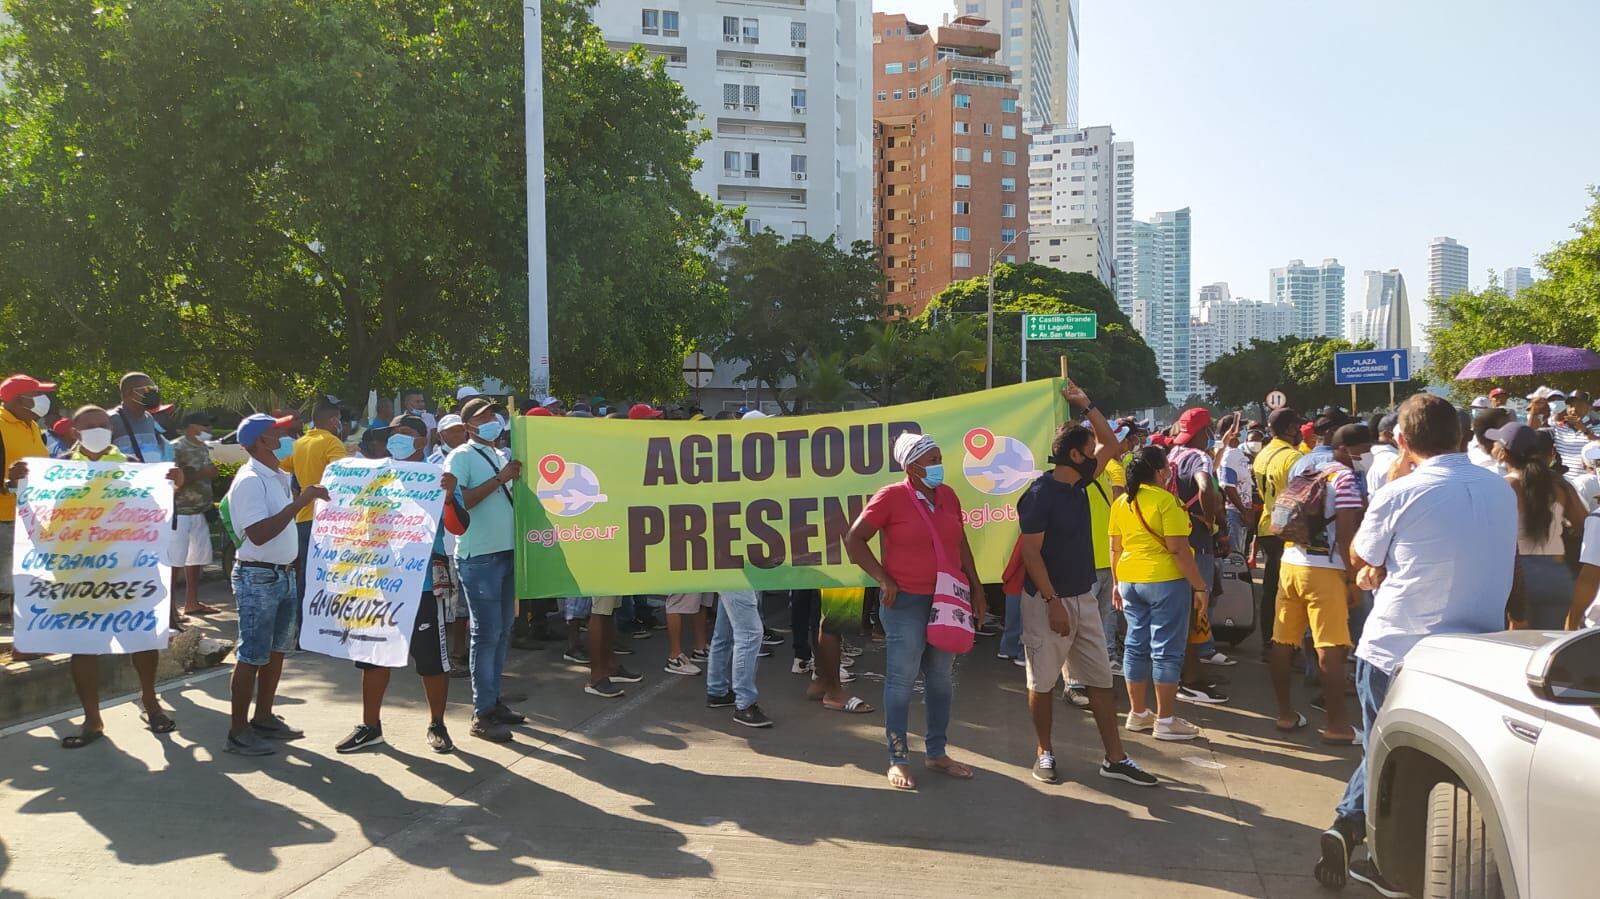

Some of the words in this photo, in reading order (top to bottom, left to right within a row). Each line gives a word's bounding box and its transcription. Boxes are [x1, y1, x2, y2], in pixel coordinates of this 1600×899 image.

[1341, 365, 1389, 374] BOCAGRANDE
[1353, 358, 1377, 366] PLAZA
[44, 465, 139, 481] QUEREMOS
[101, 486, 155, 500] SOBRE
[961, 503, 1019, 529] aglot
[316, 525, 329, 534] NO
[331, 525, 368, 536] PUEDEN
[527, 523, 619, 548] aglotour
[628, 494, 884, 573] PRESEN
[21, 550, 119, 570] QUEDAMOS
[321, 549, 338, 560] NO
[405, 557, 425, 571] QUE
[316, 568, 339, 583] DICE
[26, 578, 158, 600] SERVIDORES
[309, 589, 404, 628] AMBIENTAL
